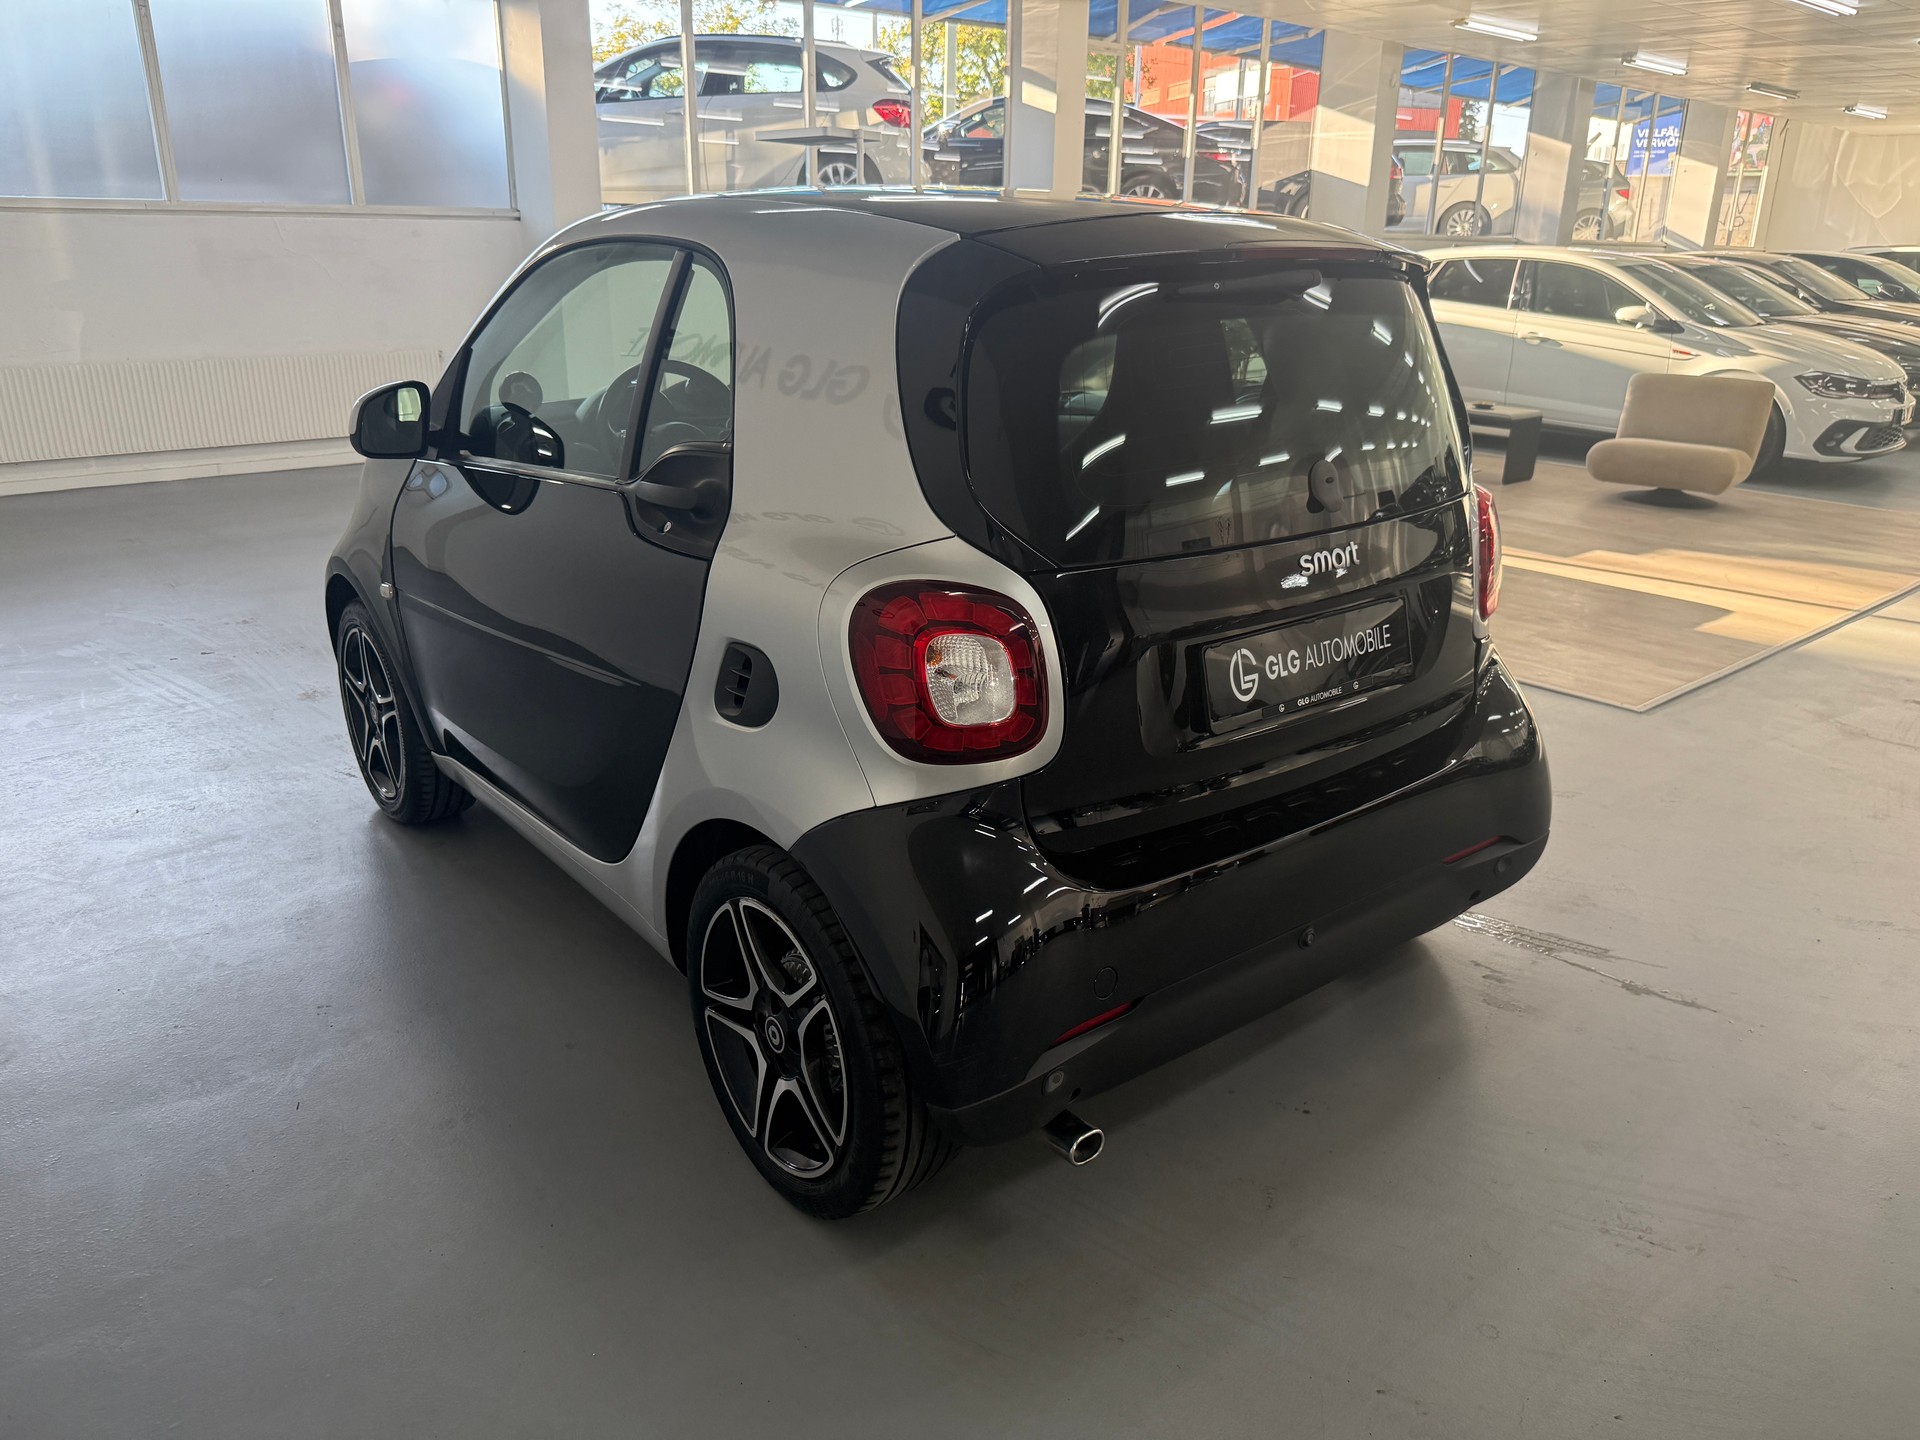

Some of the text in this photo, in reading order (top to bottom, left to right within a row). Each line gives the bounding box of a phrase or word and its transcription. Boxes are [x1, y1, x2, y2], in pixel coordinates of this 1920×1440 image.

[1637, 125, 1680, 138] VILFÄL
[1300, 541, 1360, 576] smart
[1265, 649, 1301, 680] GLG
[1305, 624, 1392, 670] AUTOMOBILE
[1297, 696, 1310, 707] GLG
[1310, 686, 1343, 703] AUTOMOBILE
